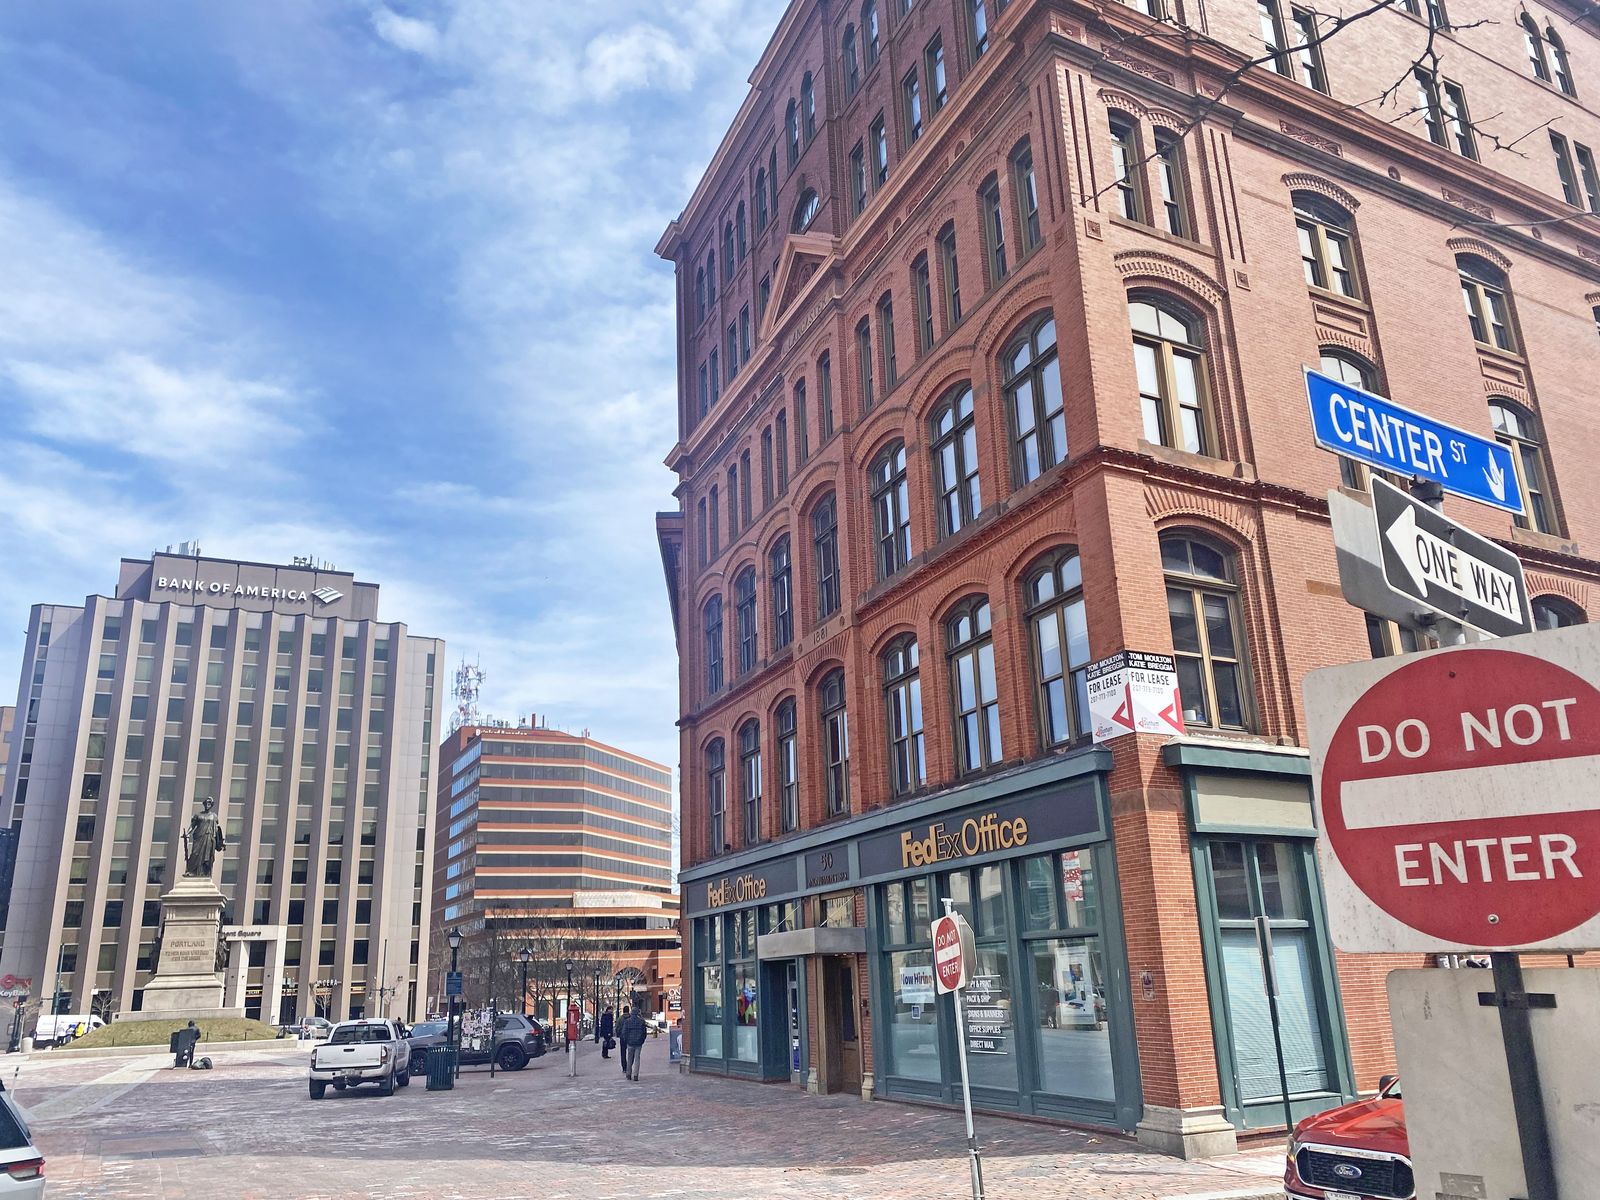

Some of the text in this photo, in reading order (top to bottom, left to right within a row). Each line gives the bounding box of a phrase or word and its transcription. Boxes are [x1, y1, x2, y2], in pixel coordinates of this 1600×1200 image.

[1329, 393, 1467, 478] CENTER ST
[1416, 534, 1514, 615] ONE WAY
[158, 576, 307, 600] BANK OF AMERICA
[813, 625, 828, 645] 1881
[1087, 653, 1124, 672] TOM MOULTON
[1128, 660, 1174, 671] KATIE BREGGIA
[1129, 652, 1172, 664] TOM MOULTON
[1087, 660, 1125, 680] KATIE BREGGIA
[1131, 671, 1170, 686] FOR LEASE
[1089, 674, 1121, 694] FOR LEASE
[1357, 697, 1577, 764] DO NOT
[901, 812, 1028, 868] FedEx Office
[1394, 833, 1583, 887] ENTER
[707, 874, 766, 908] FedEx Office
[237, 930, 261, 938] Square
[937, 929, 956, 947] DO NOT
[170, 940, 205, 948] PORTLAND
[942, 961, 959, 978] ENTER
[969, 1025, 1001, 1034] OFFICE SUPPLIES
[970, 1040, 983, 1048] DIRECT
[1339, 1165, 1354, 1176] Ford
